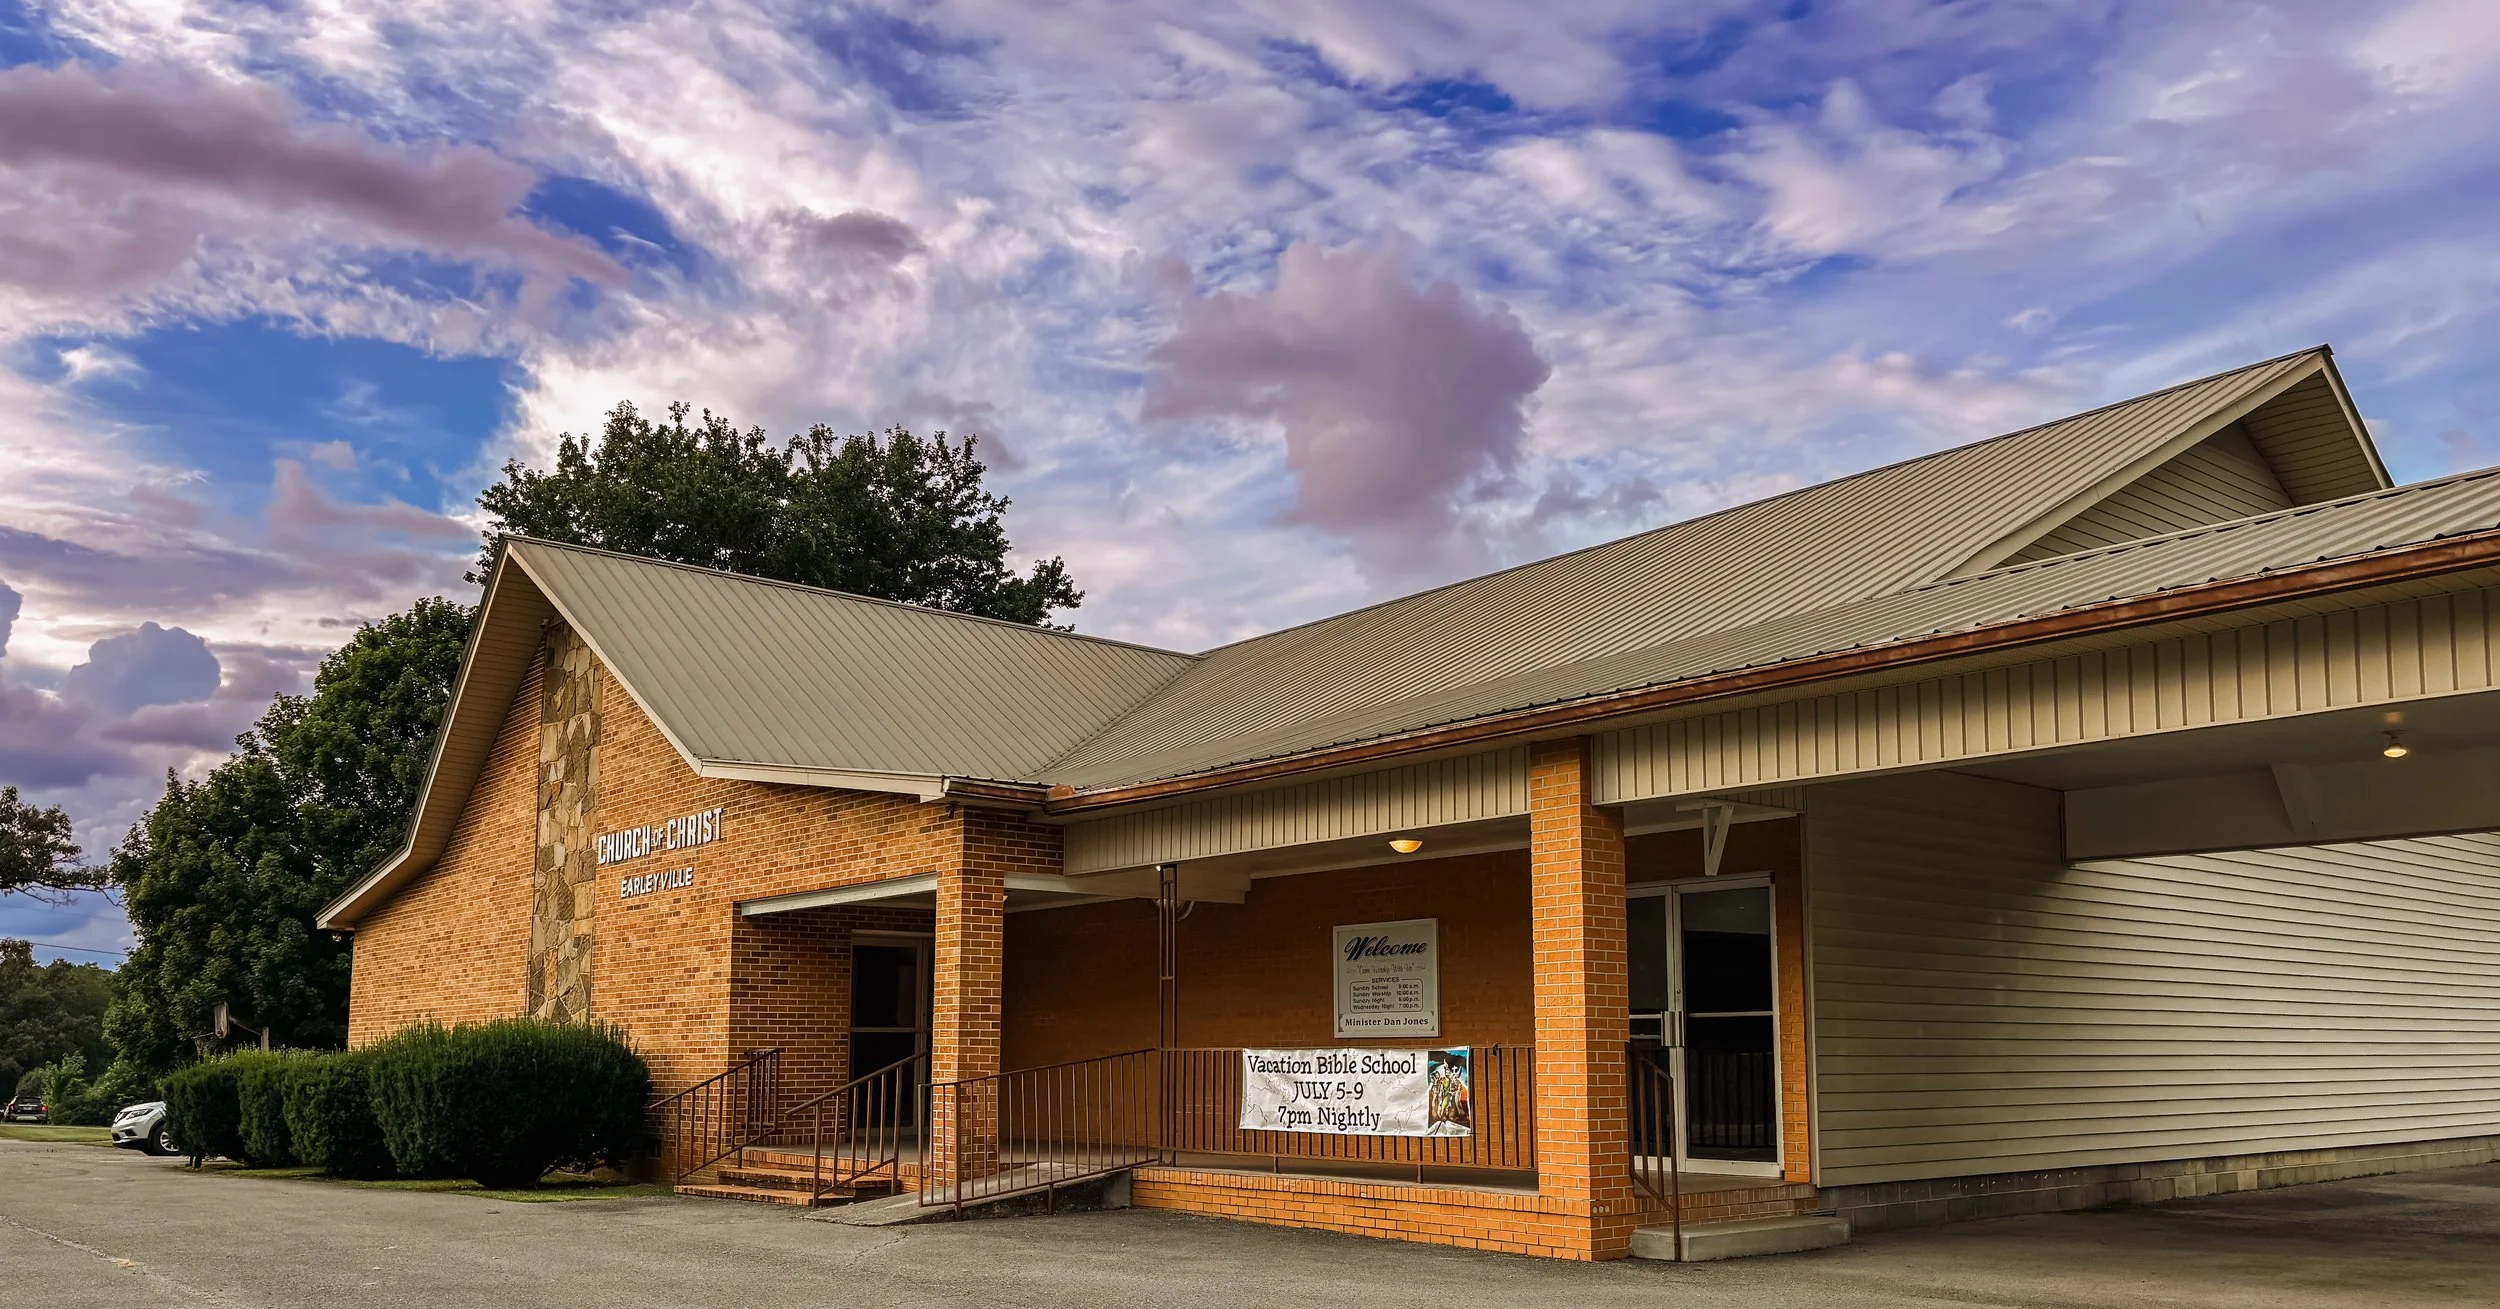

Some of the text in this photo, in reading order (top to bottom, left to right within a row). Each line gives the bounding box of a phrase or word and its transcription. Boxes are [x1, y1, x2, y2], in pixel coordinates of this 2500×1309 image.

[597, 807, 723, 865] CHURCH OF CHRIST
[621, 867, 694, 898] EARLEYVILLE
[1344, 935, 1428, 961] Welcome
[1345, 1017, 1429, 1026] Minister Dan Jones
[1247, 1053, 1417, 1075] Vacation Bible School
[1291, 1081, 1364, 1103] JULY 5-9
[1278, 1105, 1381, 1132] 7pm Nightly
